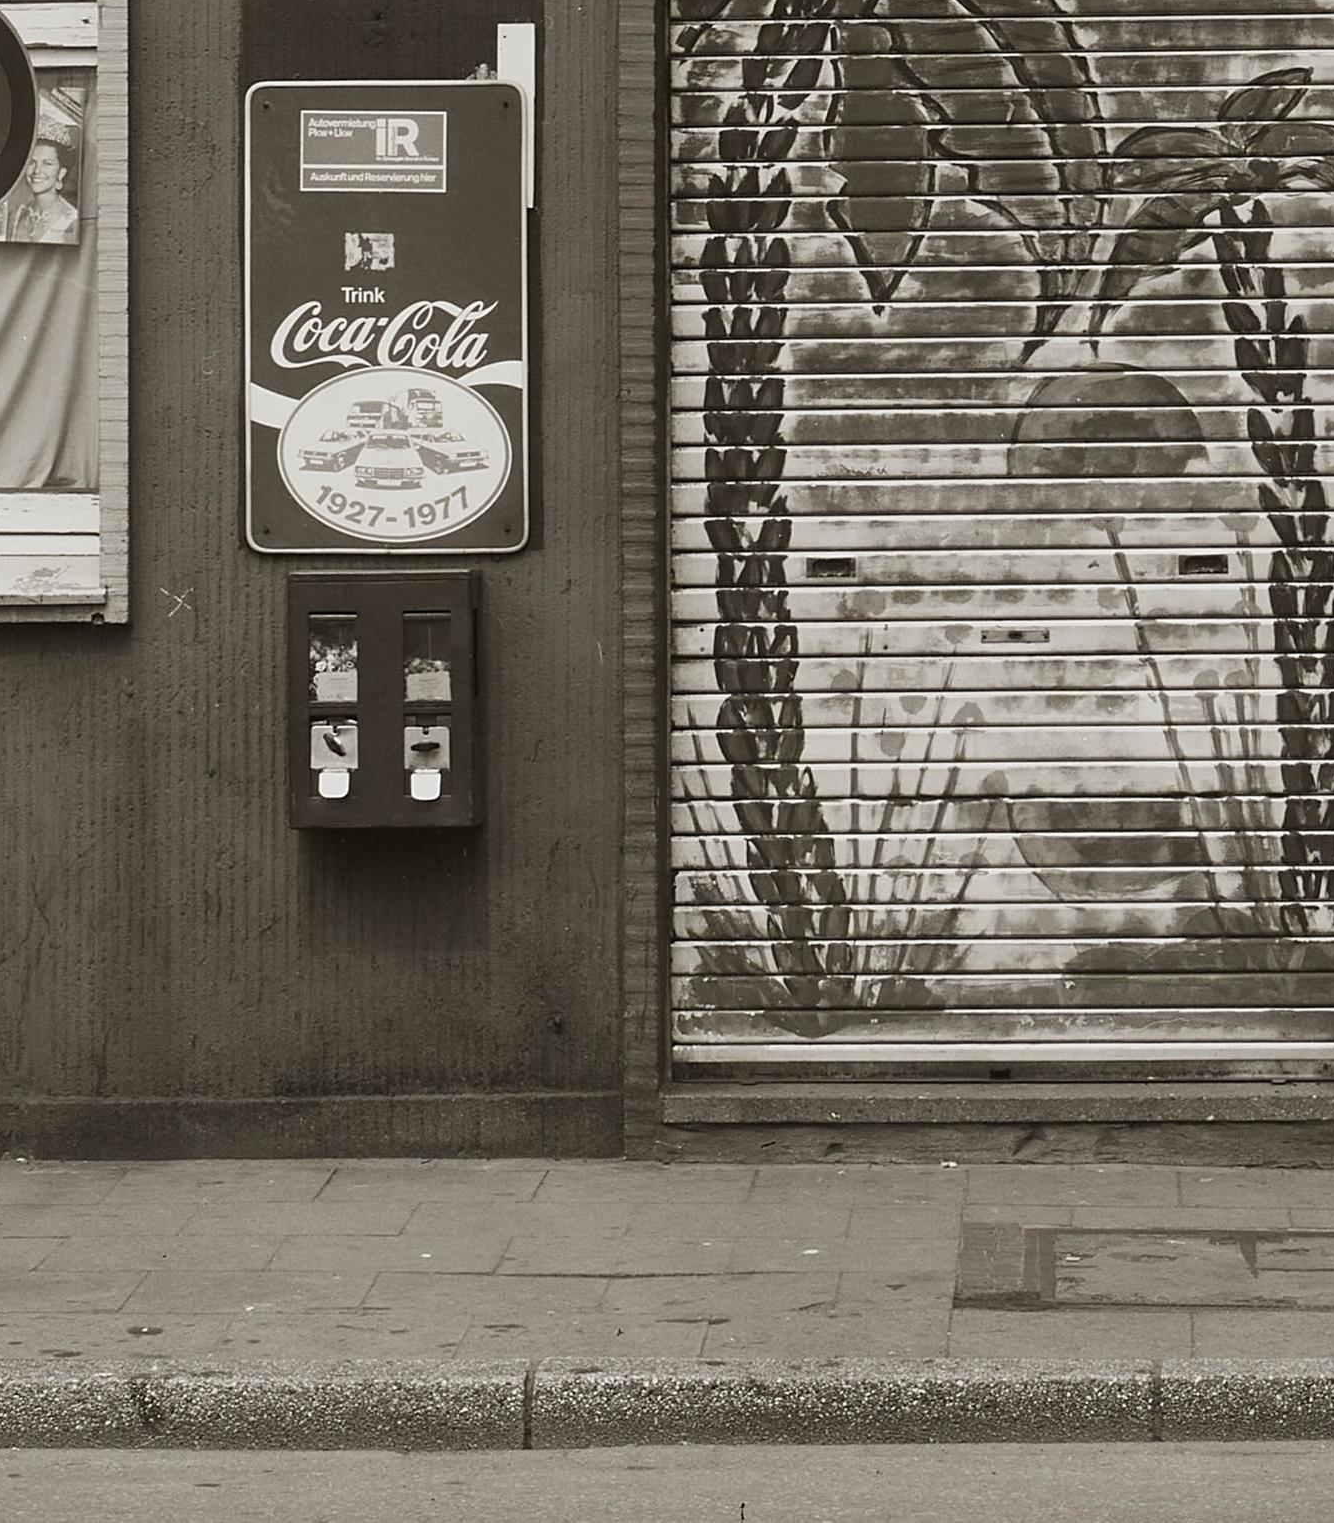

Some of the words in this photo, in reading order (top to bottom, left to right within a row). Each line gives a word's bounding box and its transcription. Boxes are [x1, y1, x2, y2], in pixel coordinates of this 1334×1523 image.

[341, 287, 386, 303] Trink
[270, 300, 499, 368] Coca-Cola
[316, 485, 469, 527] 1927-1977
